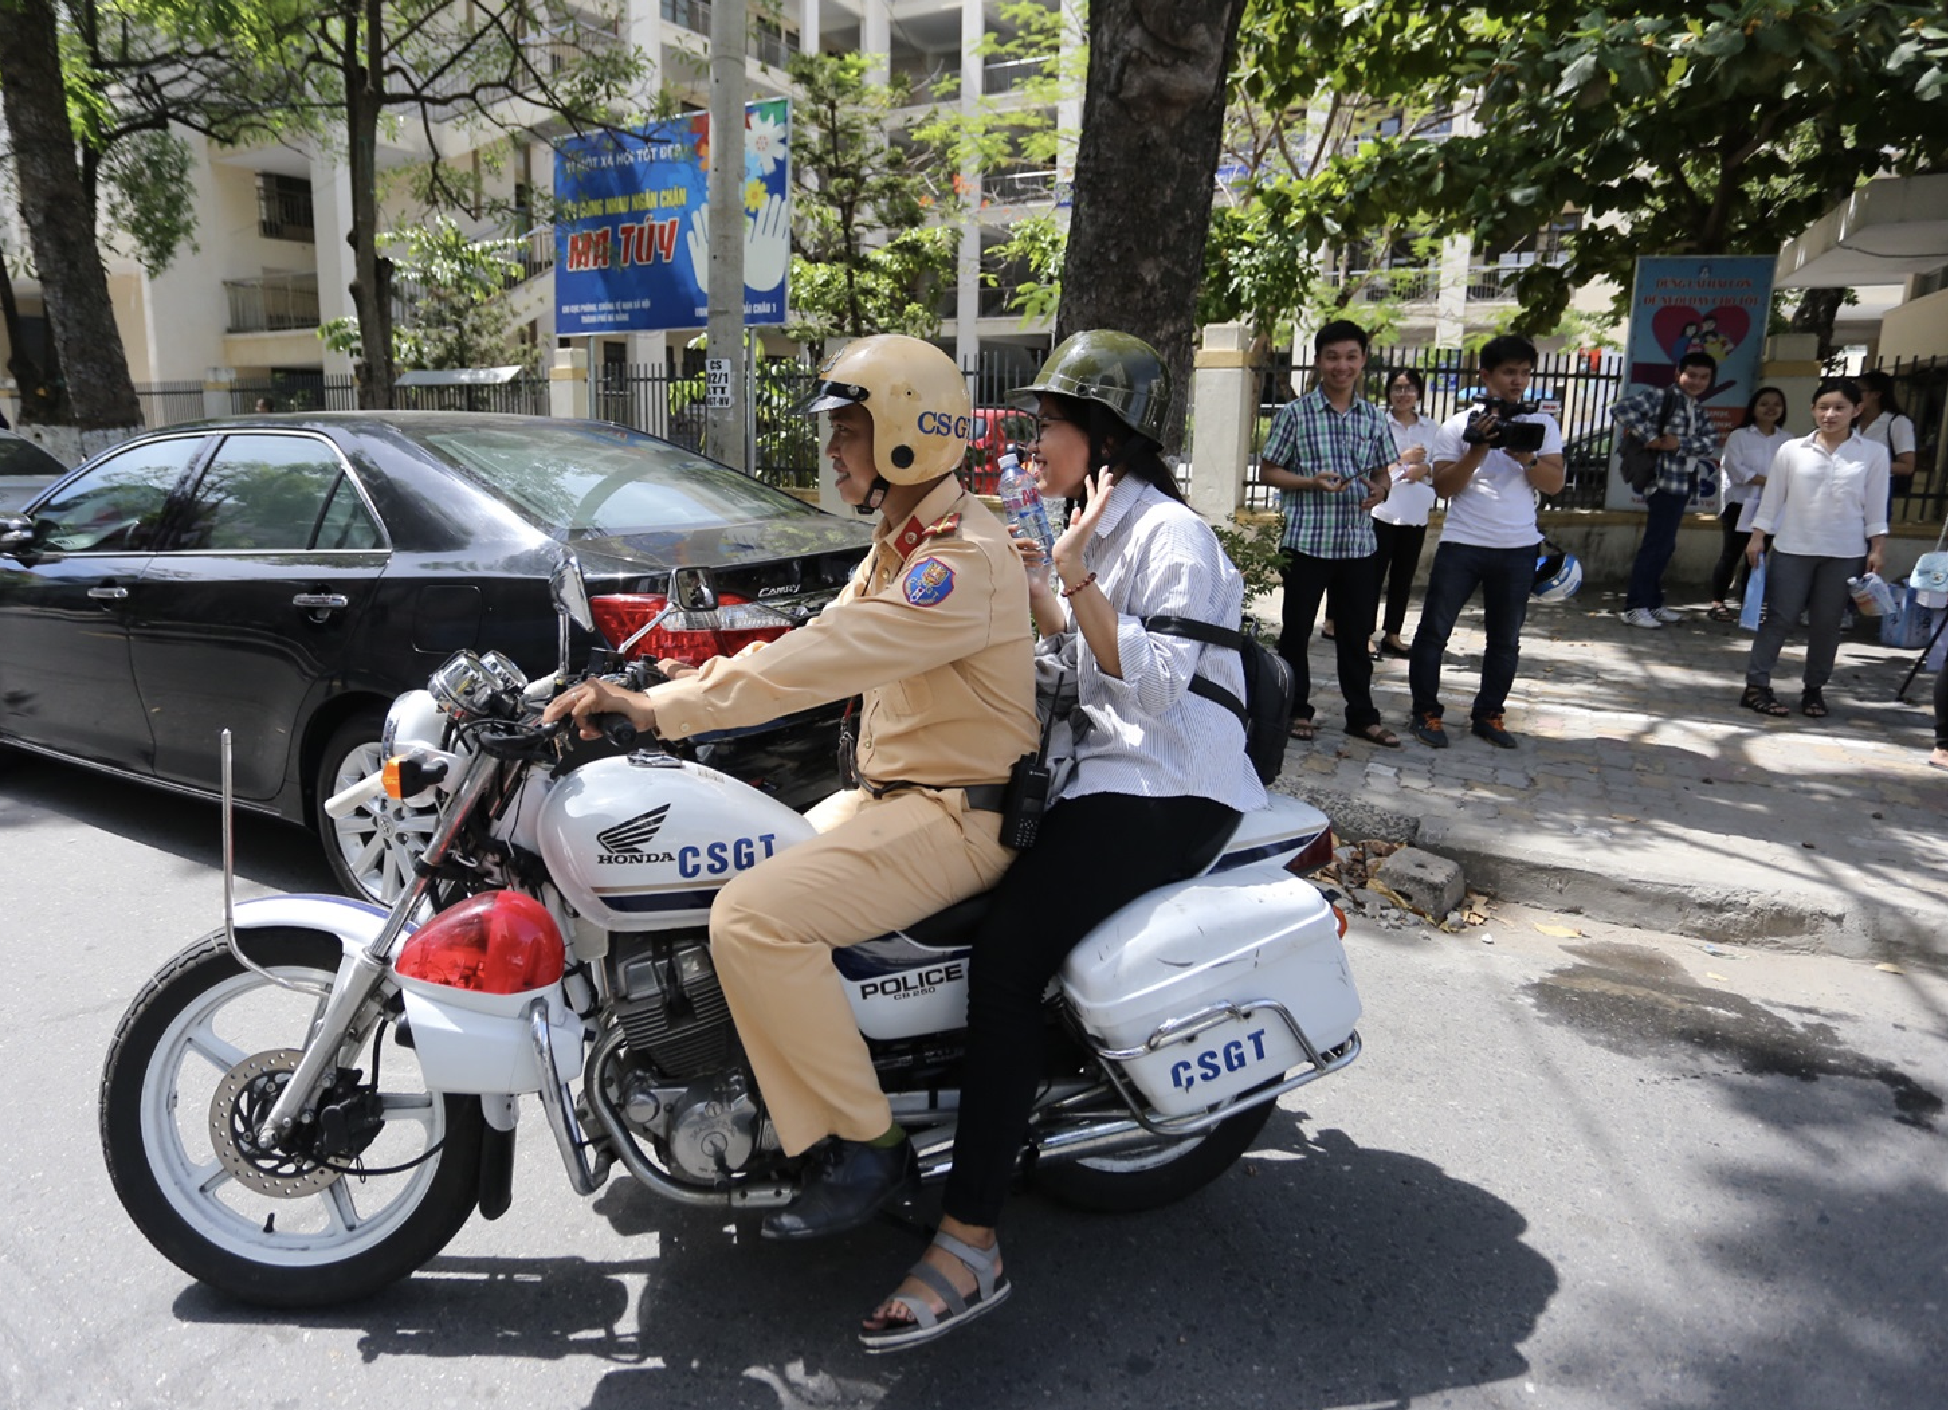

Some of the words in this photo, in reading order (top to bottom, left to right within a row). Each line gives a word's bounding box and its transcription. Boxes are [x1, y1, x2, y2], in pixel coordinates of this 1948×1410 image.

[619, 214, 679, 267] TÚY
[597, 851, 676, 864] HONDA
[678, 833, 775, 878] CSGT
[860, 963, 963, 1000] POLICE
[1170, 1028, 1266, 1089] CSGT
